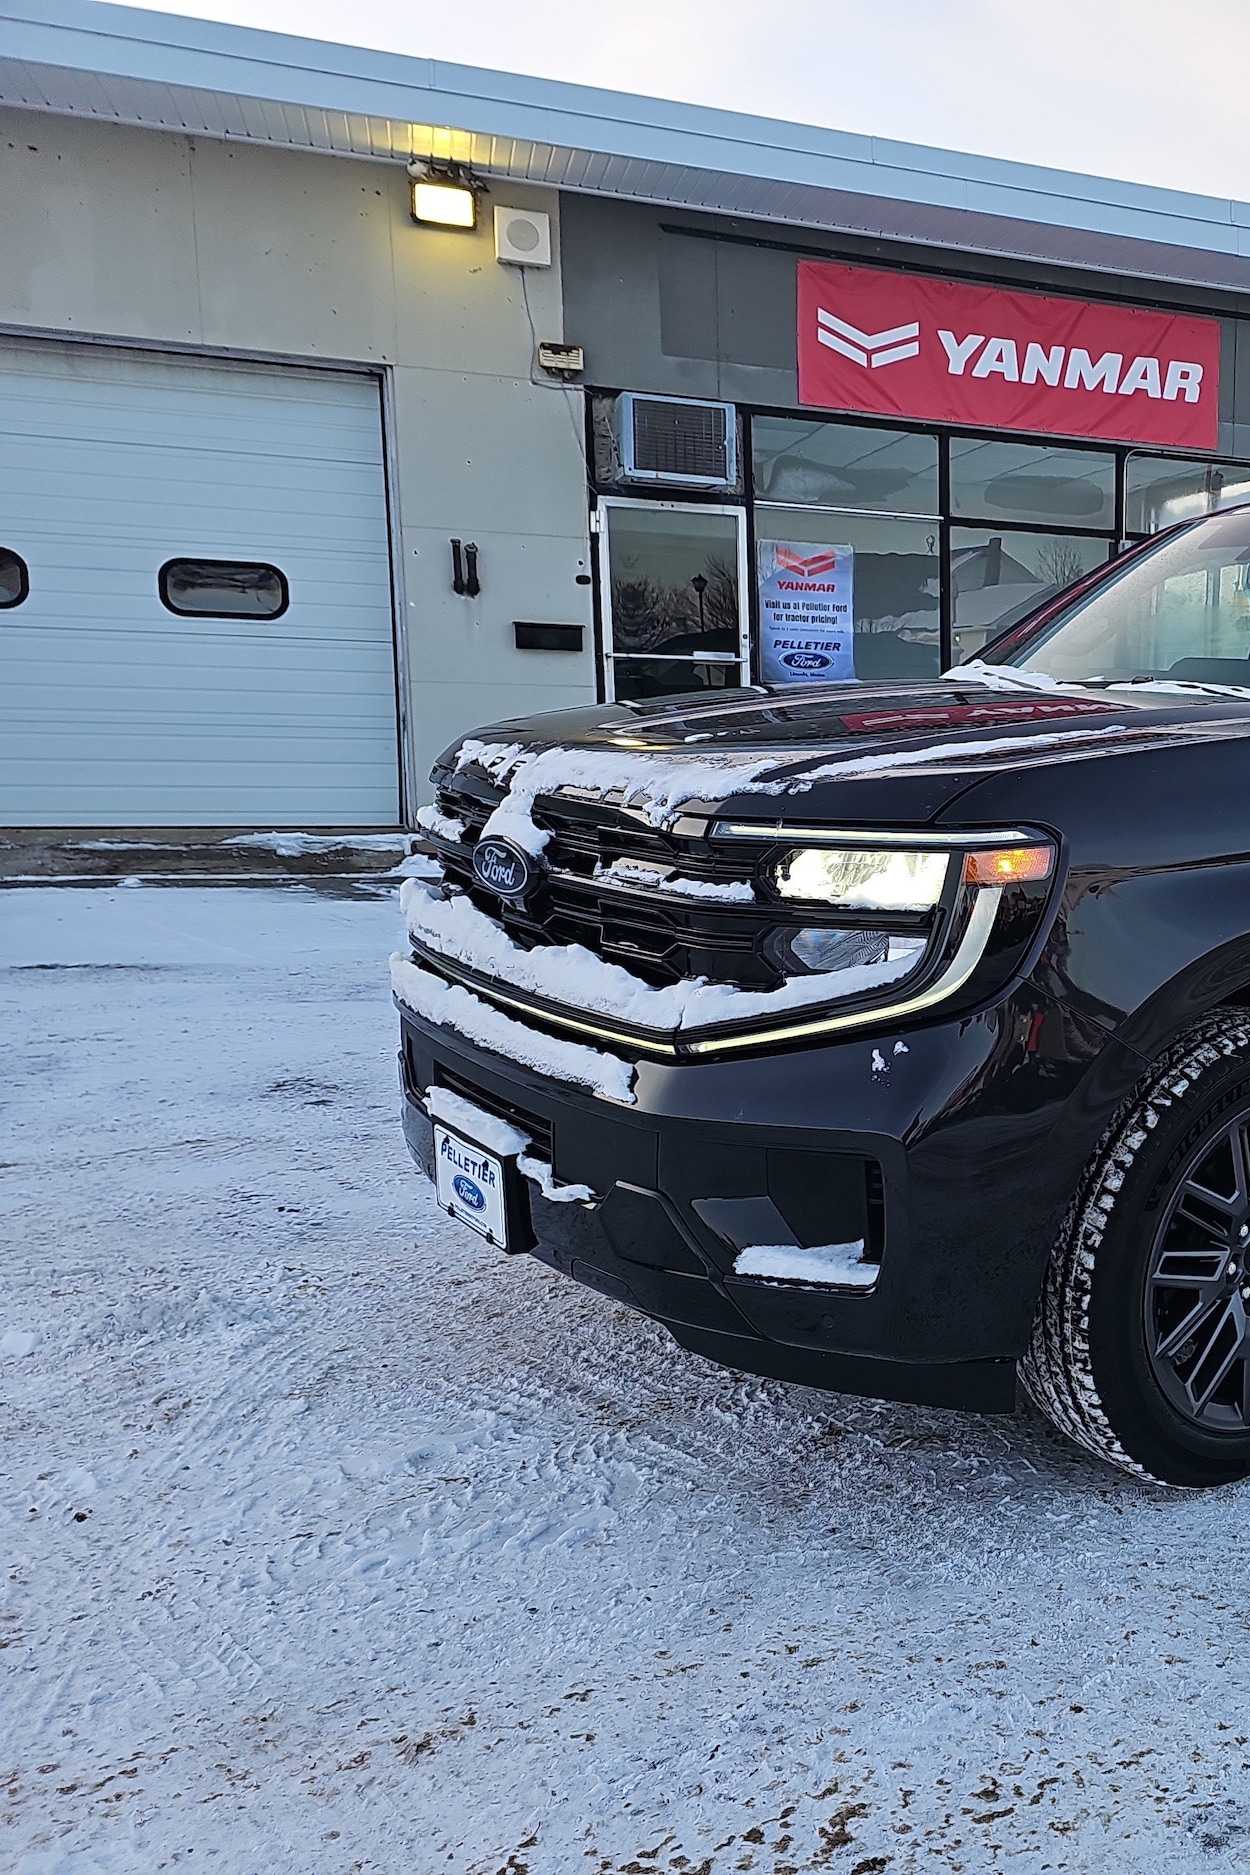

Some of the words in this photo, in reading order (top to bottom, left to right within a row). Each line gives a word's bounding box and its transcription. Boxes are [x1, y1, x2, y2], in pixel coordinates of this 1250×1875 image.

[937, 329, 1203, 403] YANMAR
[777, 580, 836, 593] YANMAR
[765, 600, 780, 610] Visit
[782, 601, 791, 610] us
[793, 601, 800, 610] at
[802, 602, 831, 612] Pelletier
[832, 603, 848, 613] Ford
[773, 612, 783, 622] for
[785, 612, 810, 623] tractor
[811, 614, 838, 625] pricing!
[773, 639, 842, 651] PELLETIER
[791, 653, 822, 668] Ford
[482, 846, 515, 886] Ford
[440, 1142, 496, 1189] PELLETIER
[458, 1179, 479, 1207] Ford
